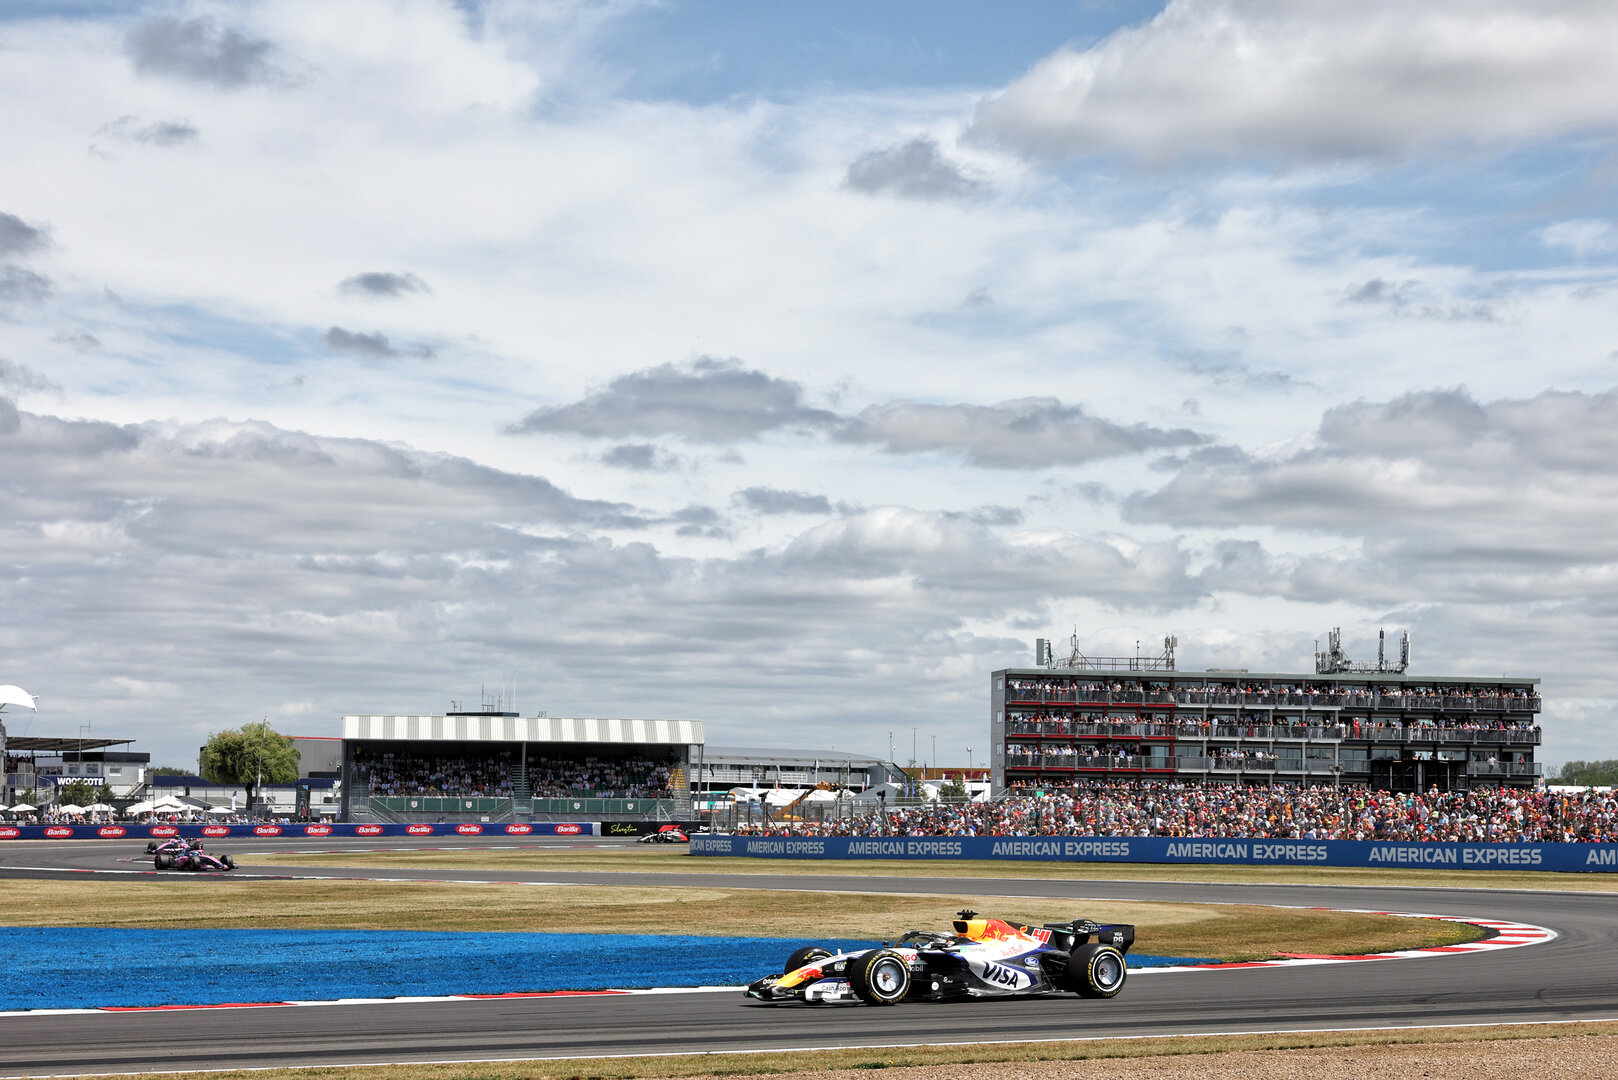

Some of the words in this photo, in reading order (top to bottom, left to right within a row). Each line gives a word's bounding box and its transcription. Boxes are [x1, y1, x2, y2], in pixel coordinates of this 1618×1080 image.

[152, 828, 177, 836] Barilla
[705, 839, 732, 852] EXPRESS
[746, 841, 785, 853] AMERICAN
[786, 842, 825, 854] EXPRESS
[848, 842, 904, 855] AMERICAN
[907, 842, 962, 855] EXPRESS
[992, 842, 1061, 856] AMERICAN
[1064, 842, 1130, 856] EXPRESS
[1166, 843, 1247, 859] AMERICAN
[1252, 845, 1328, 861] EXPRESS
[1368, 847, 1458, 864] AMERICAN
[1462, 849, 1542, 865] EXPRESS
[1586, 850, 1618, 865] AM
[1032, 929, 1050, 944] 41
[982, 961, 1019, 989] VISA
